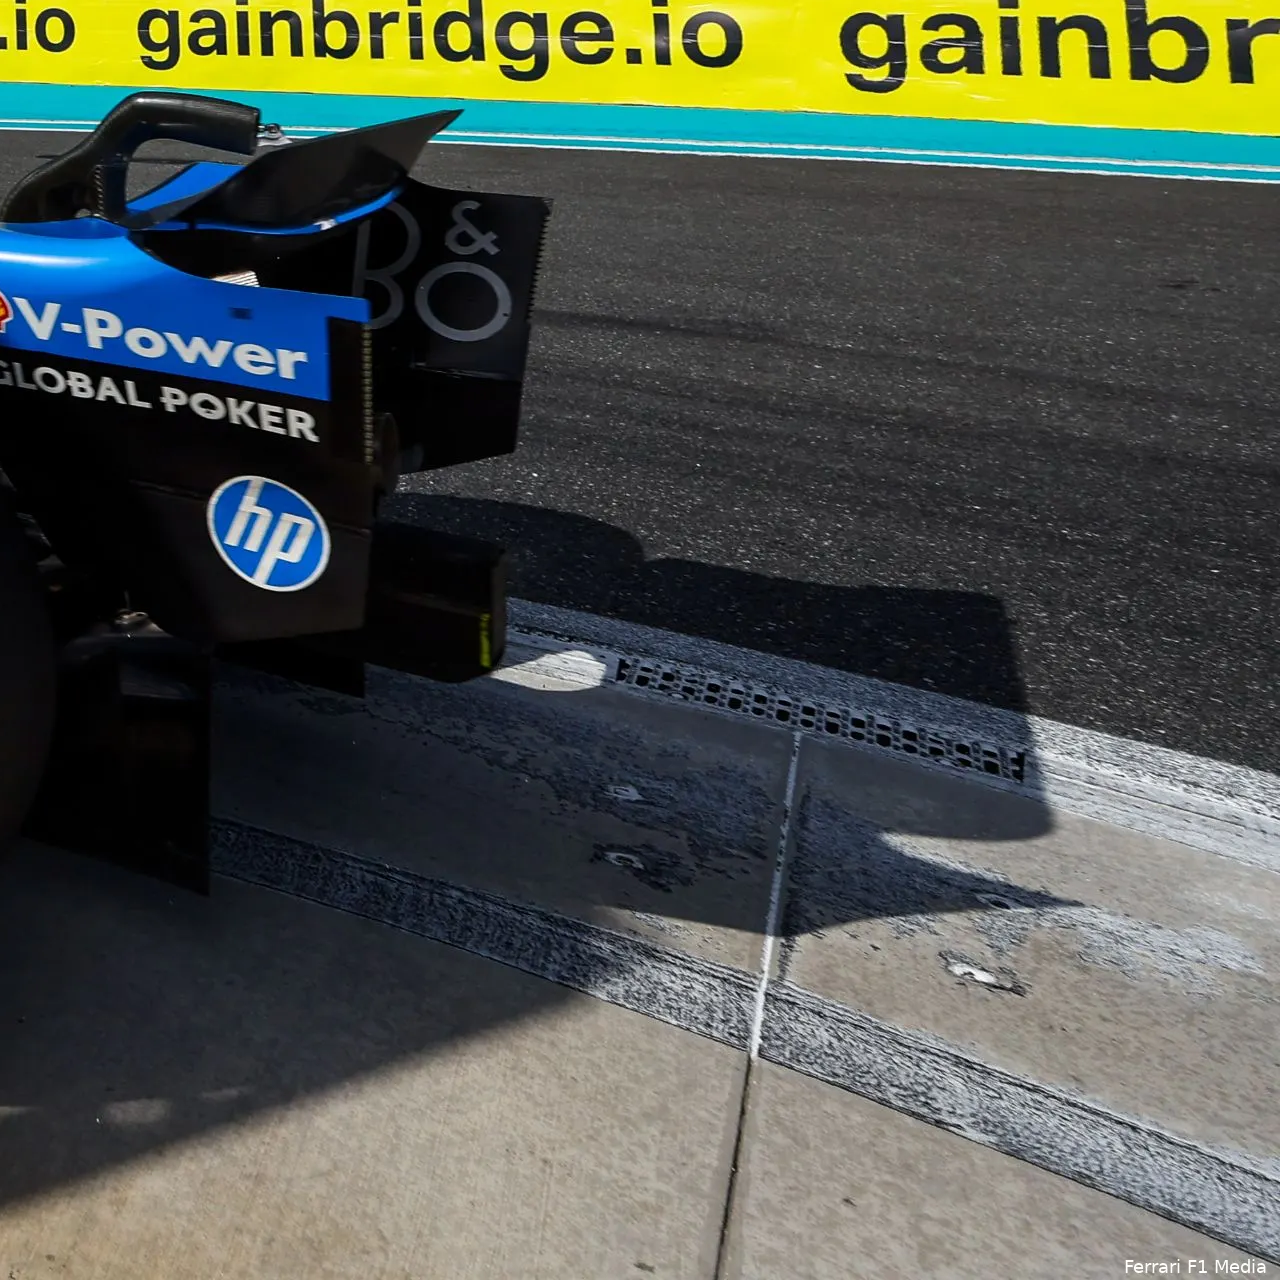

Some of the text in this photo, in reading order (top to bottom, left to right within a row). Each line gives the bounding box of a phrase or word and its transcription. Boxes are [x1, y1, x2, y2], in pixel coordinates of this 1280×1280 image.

[12, 297, 308, 380] V-Power
[160, 386, 320, 443] POKER
[224, 477, 316, 589] hp
